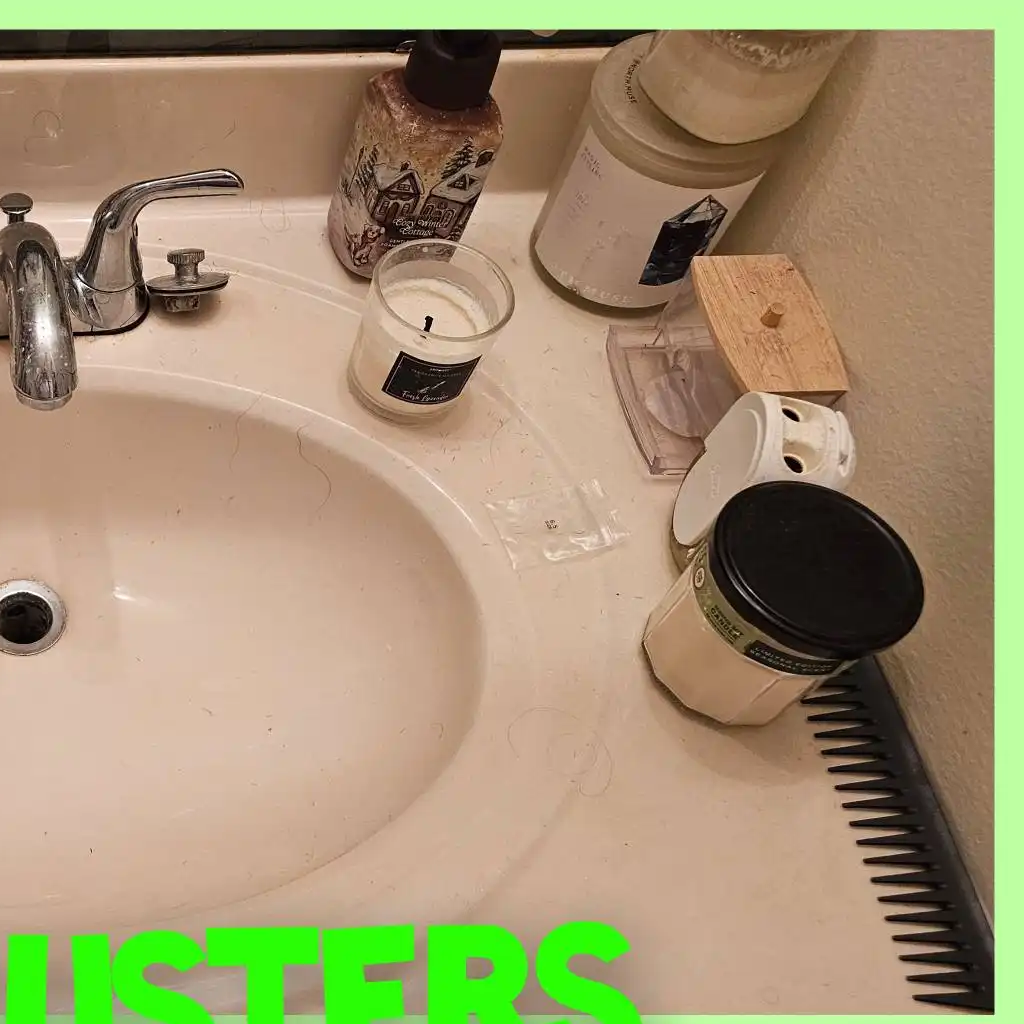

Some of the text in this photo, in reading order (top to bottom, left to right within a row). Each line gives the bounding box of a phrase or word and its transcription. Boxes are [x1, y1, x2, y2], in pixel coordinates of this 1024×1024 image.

[393, 218, 448, 229] Cozy Winter
[399, 227, 434, 236] Cottage
